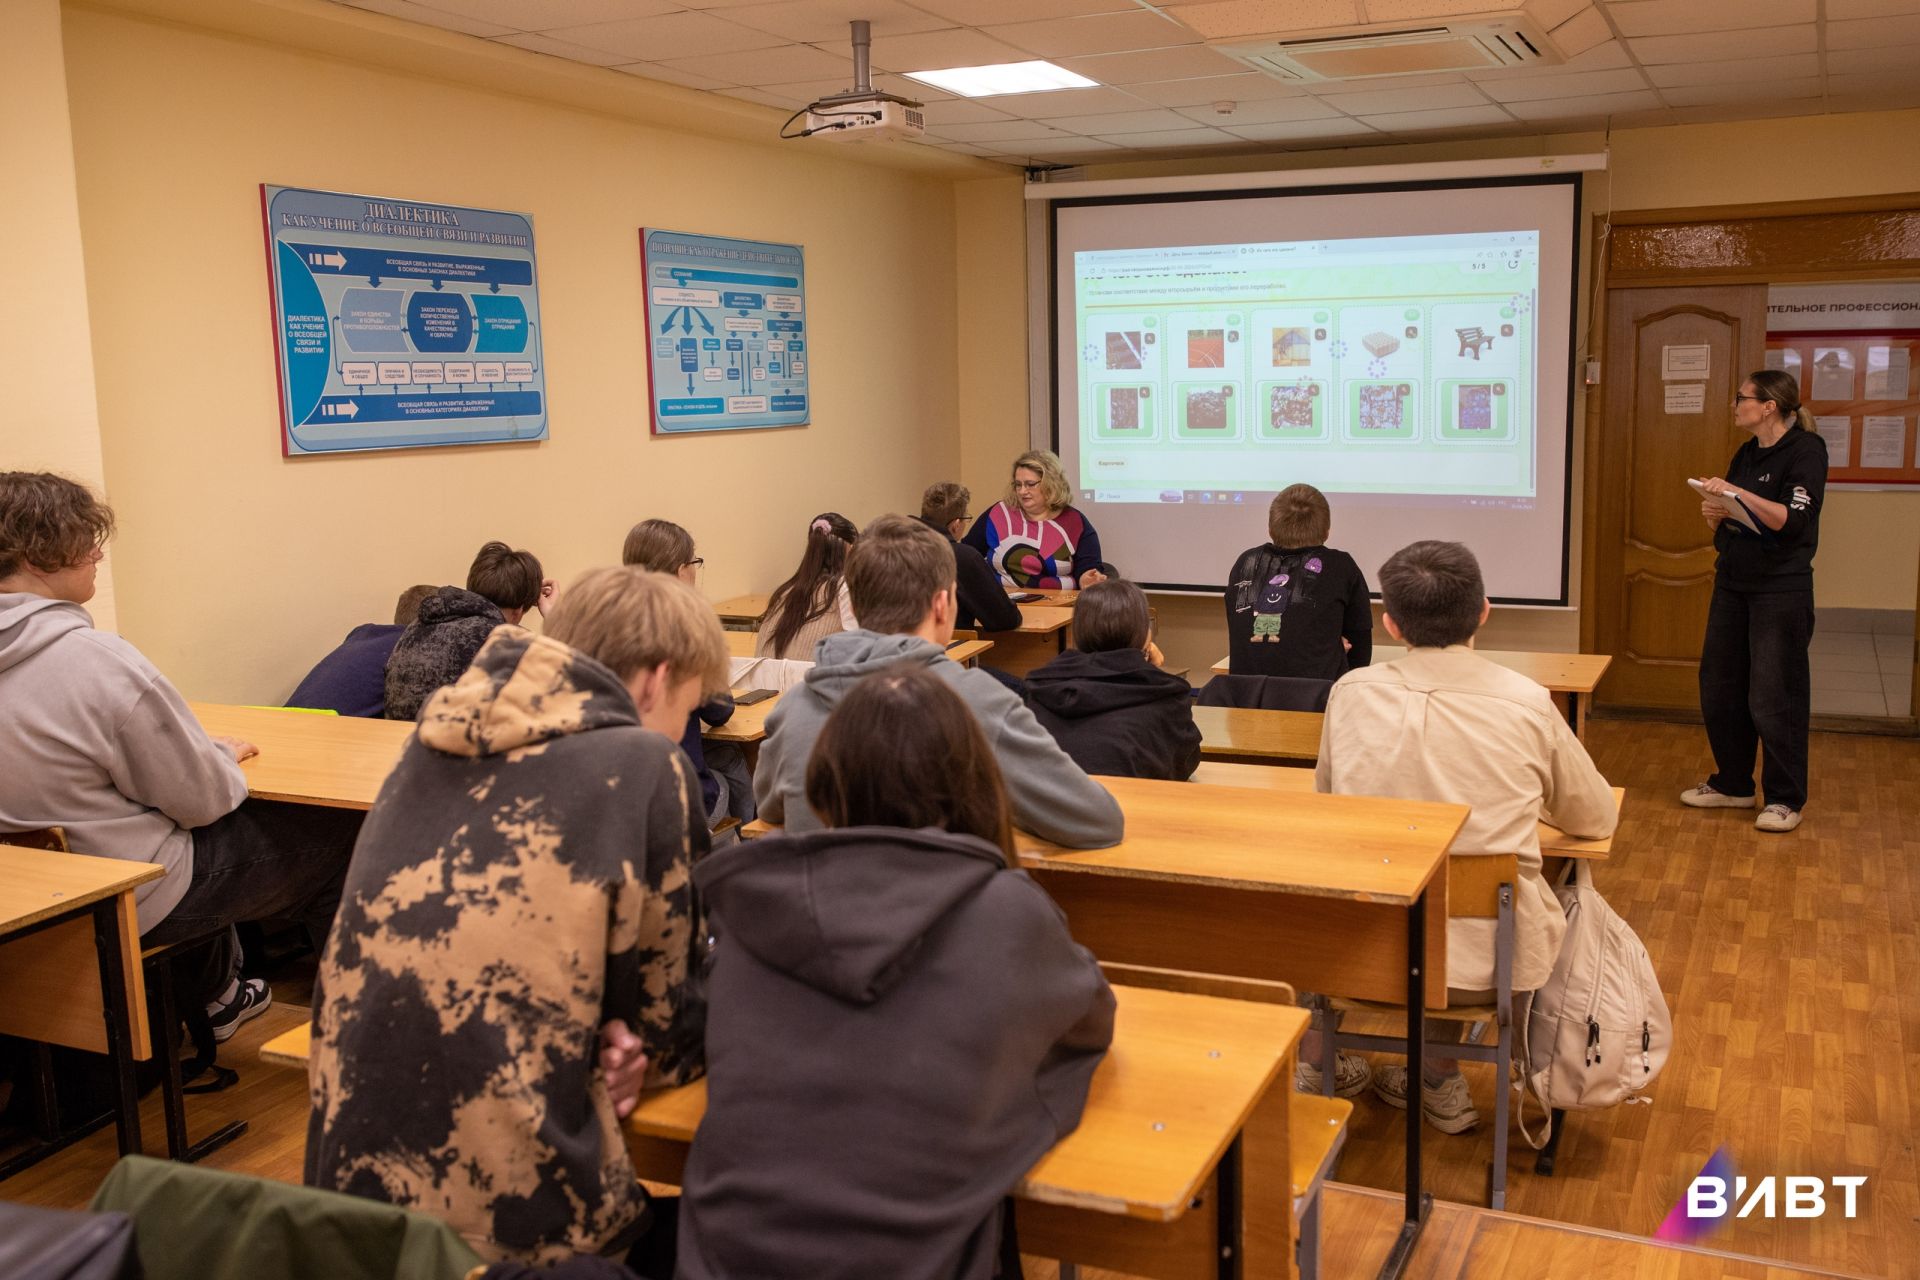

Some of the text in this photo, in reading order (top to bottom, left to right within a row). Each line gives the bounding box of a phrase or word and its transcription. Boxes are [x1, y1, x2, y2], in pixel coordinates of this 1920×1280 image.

[364, 202, 460, 226] ДИАЛЕКТИКА
[282, 213, 527, 247] КАК УЧЕНИЕ О ВСЕОБЩЕЙ СВЯЗИ И РАЗВИТИИ
[1830, 302, 1920, 312] ПРОФЕССИОН
